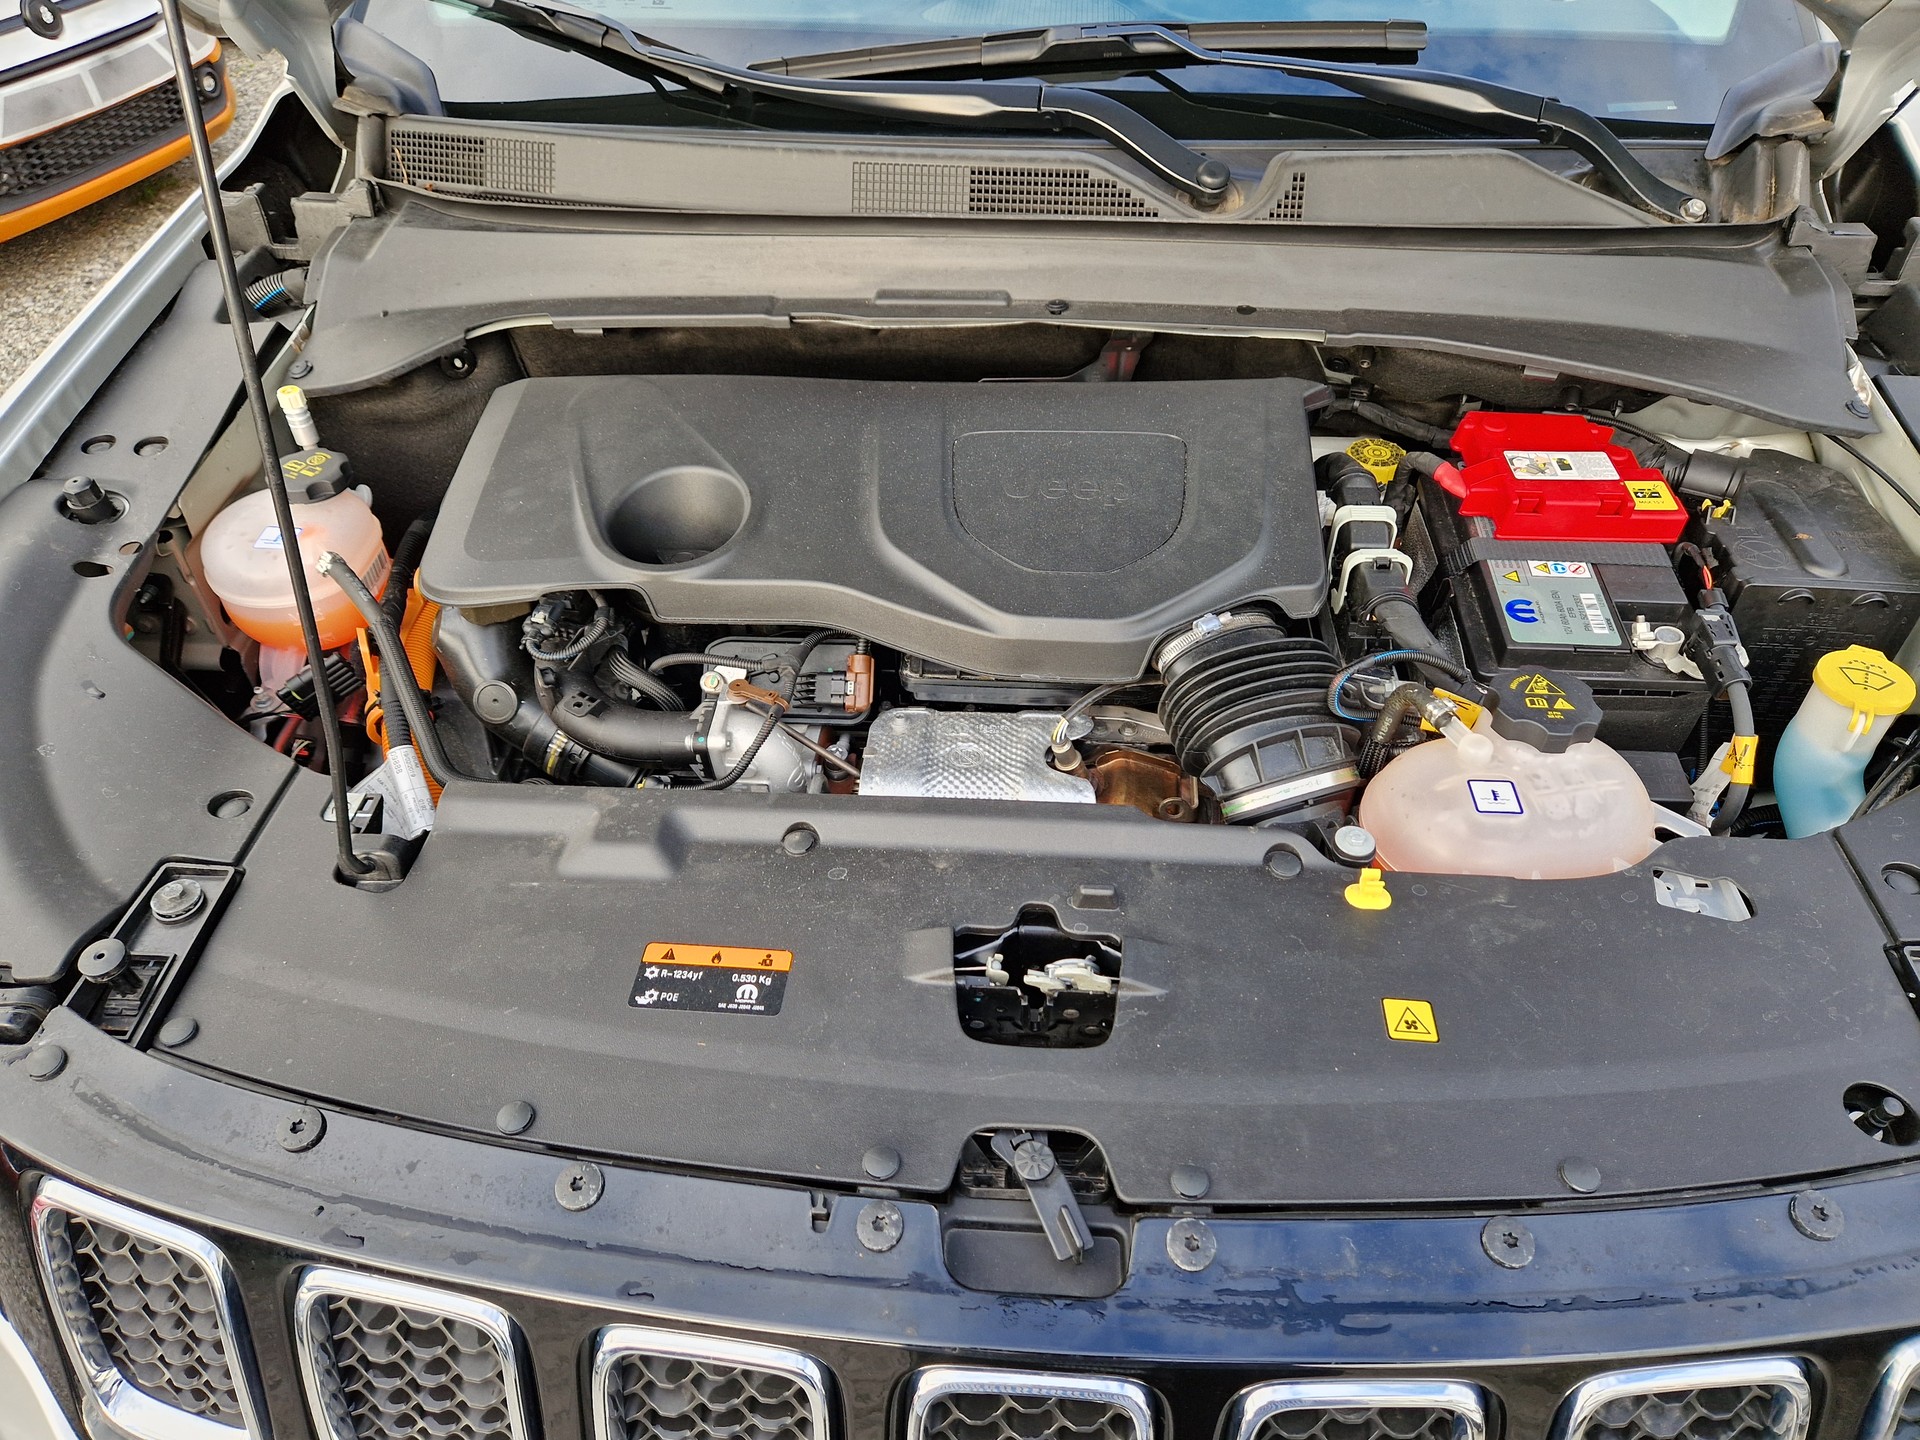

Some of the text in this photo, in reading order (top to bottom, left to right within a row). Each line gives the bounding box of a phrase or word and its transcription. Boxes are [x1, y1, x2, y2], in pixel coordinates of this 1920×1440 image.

[1003, 474, 1132, 506] Jeep
[1566, 606, 1577, 619] EFB
[660, 969, 704, 980] R-1234yf
[732, 973, 772, 986] 0.530 Kg
[660, 992, 679, 1002] POE
